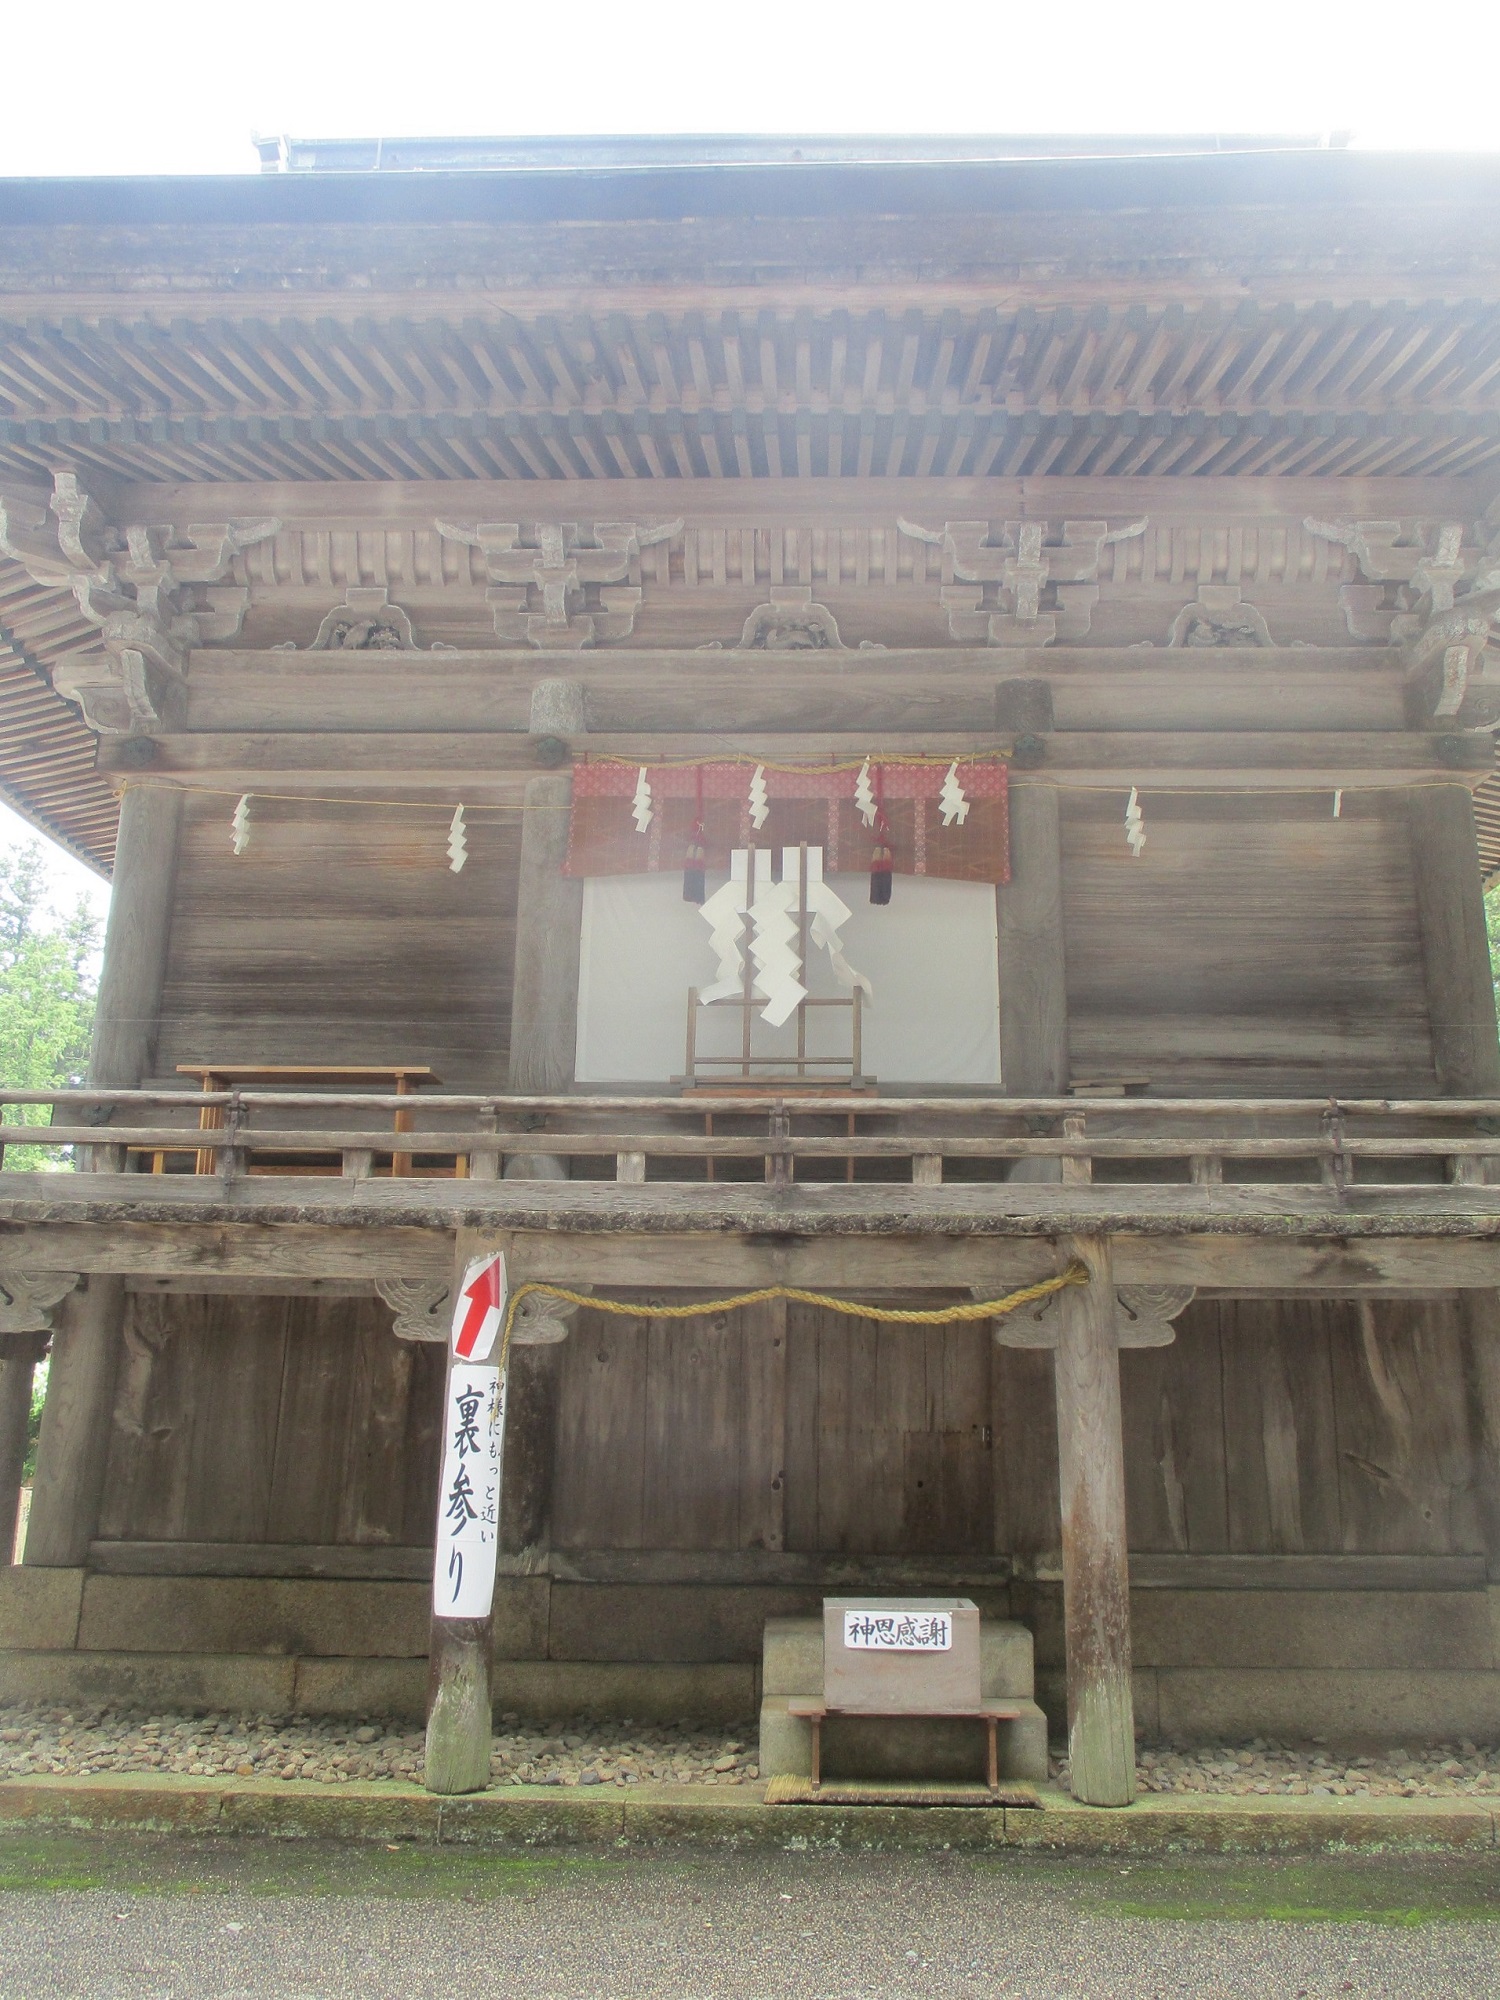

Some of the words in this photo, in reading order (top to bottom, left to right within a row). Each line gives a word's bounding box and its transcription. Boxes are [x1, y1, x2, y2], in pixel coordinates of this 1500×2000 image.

[445, 1384, 485, 1603] 裏参り
[849, 1616, 948, 1646] 神恩感謝
